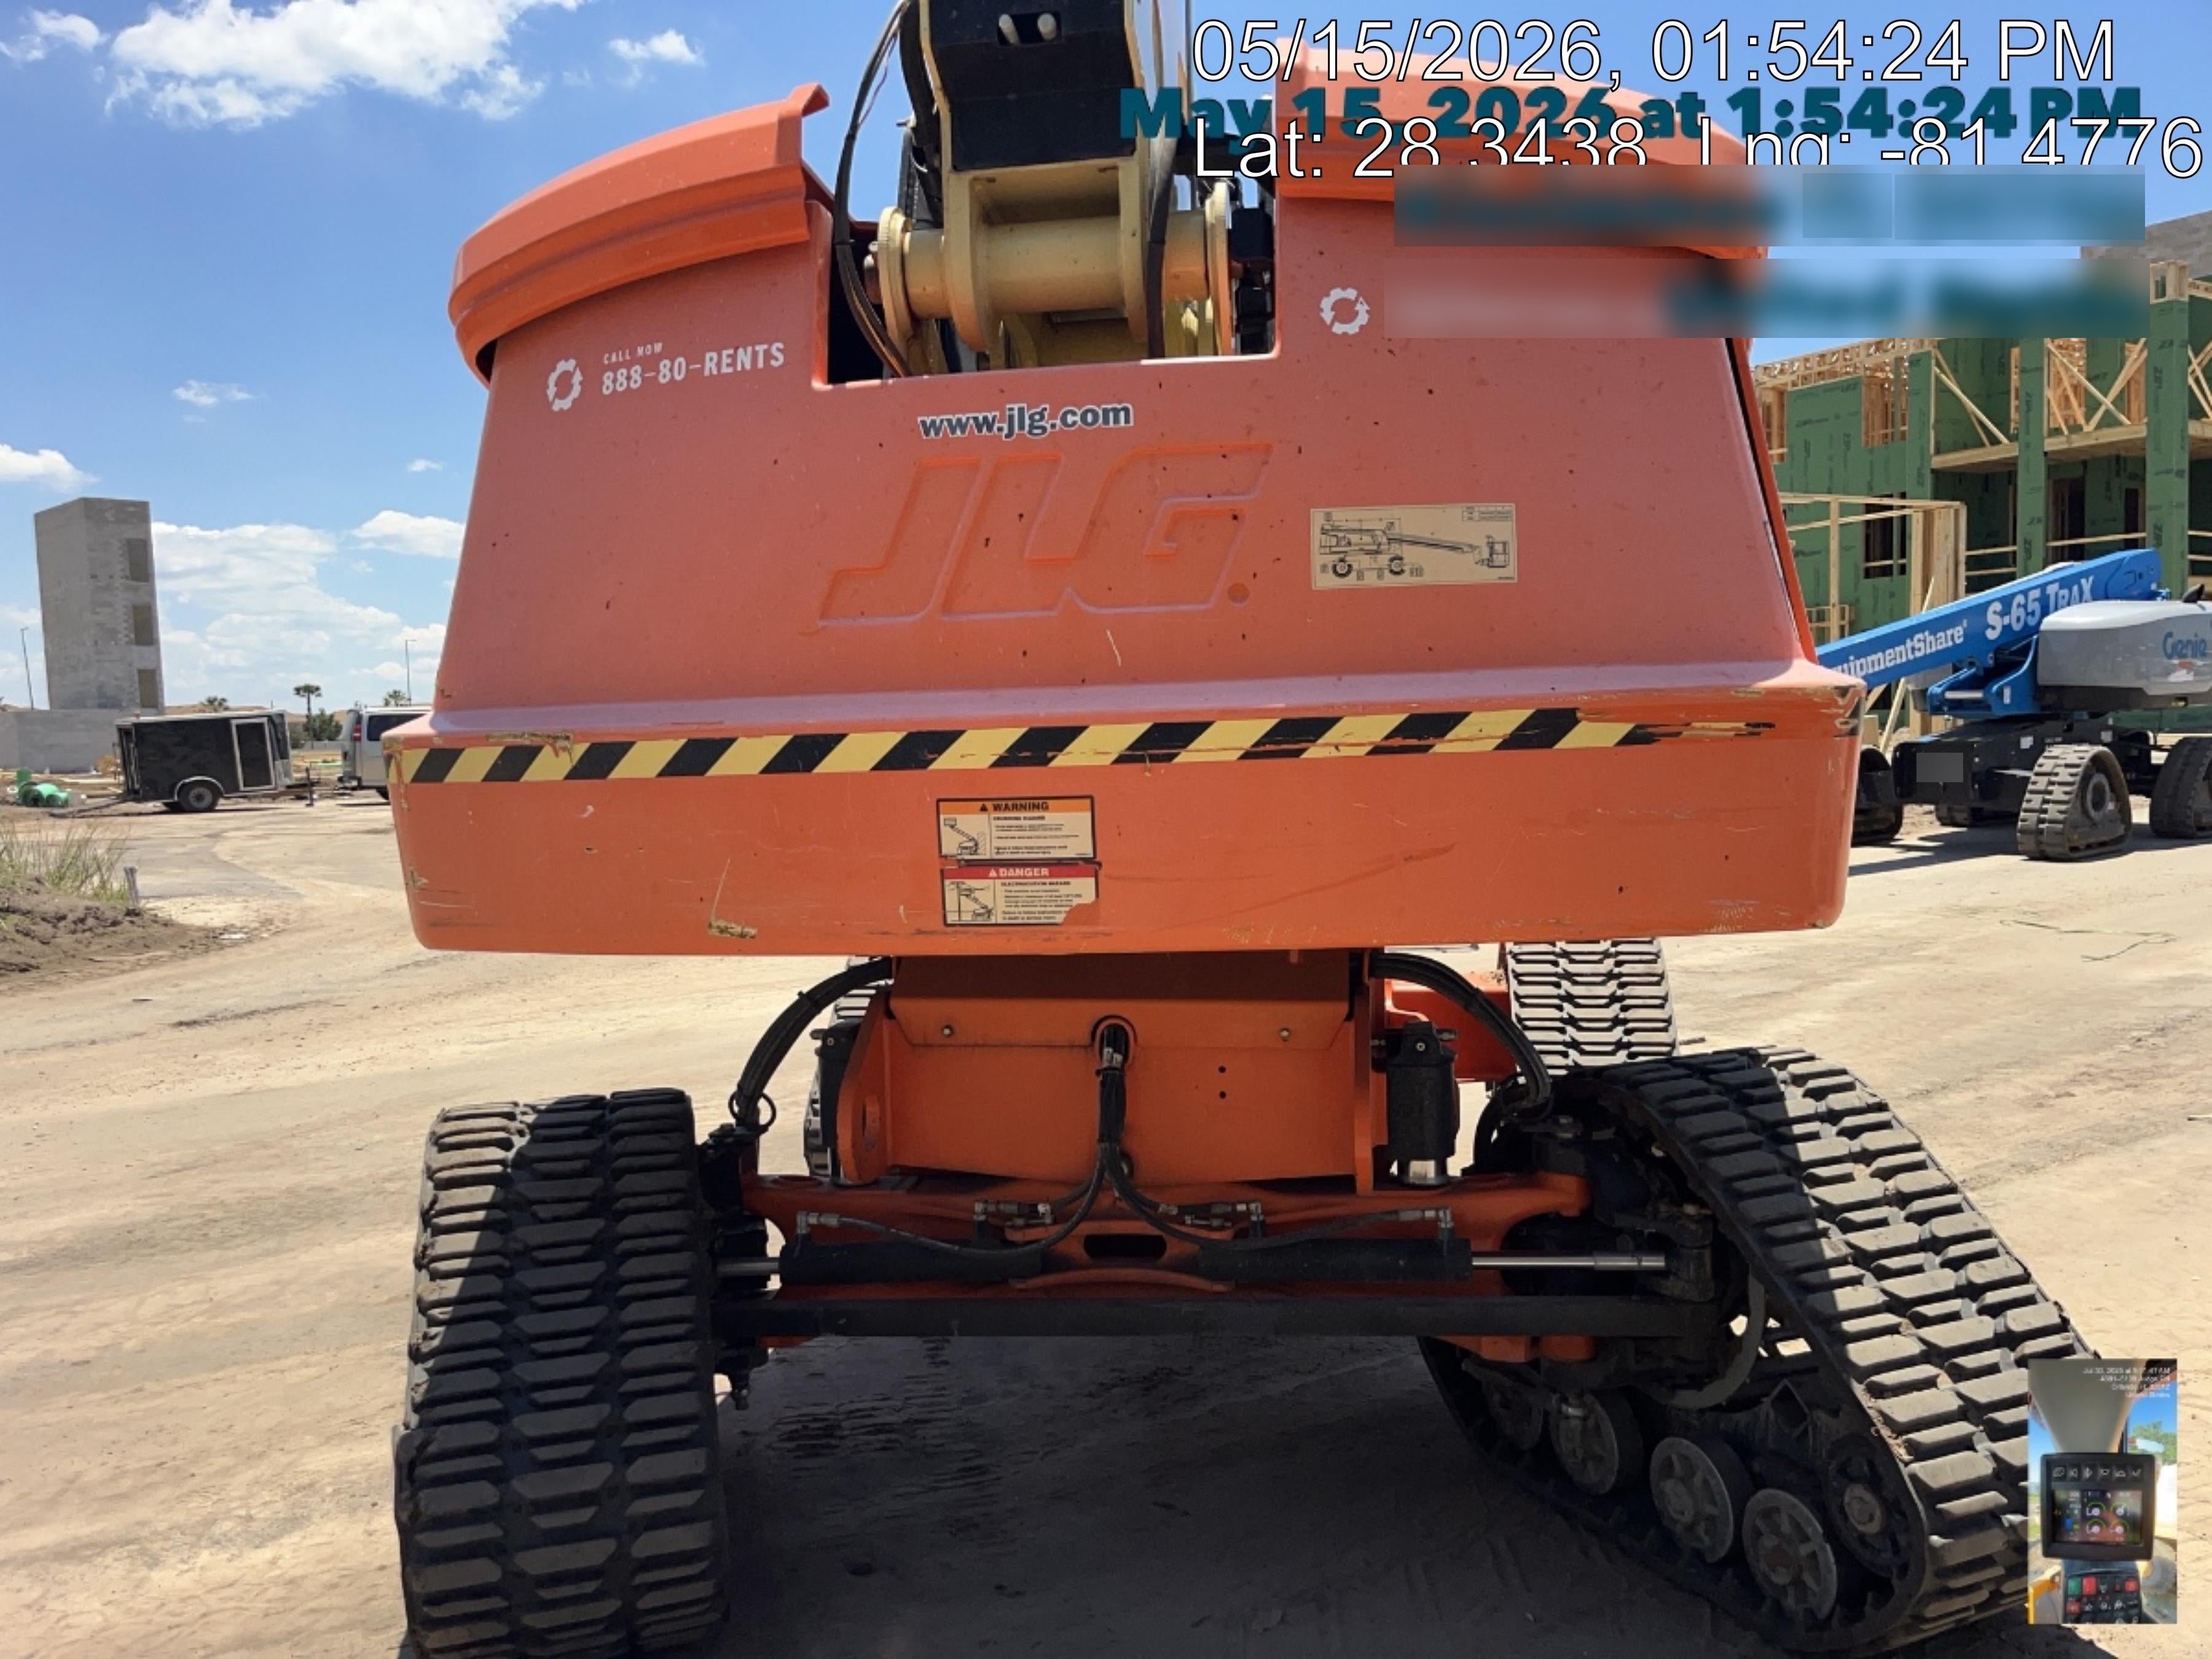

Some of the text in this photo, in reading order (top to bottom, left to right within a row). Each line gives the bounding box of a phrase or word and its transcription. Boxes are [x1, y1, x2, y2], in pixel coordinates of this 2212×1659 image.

[602, 342, 786, 396] 888-80-RENTS
[603, 342, 664, 365] CALL NOW
[919, 404, 1134, 440] www.jlg.com
[818, 443, 1275, 626] JLG
[1985, 588, 2041, 640] S-65
[2162, 632, 2208, 660] Genie
[992, 801, 1049, 812] WARNING
[999, 868, 1049, 877] DANGER
